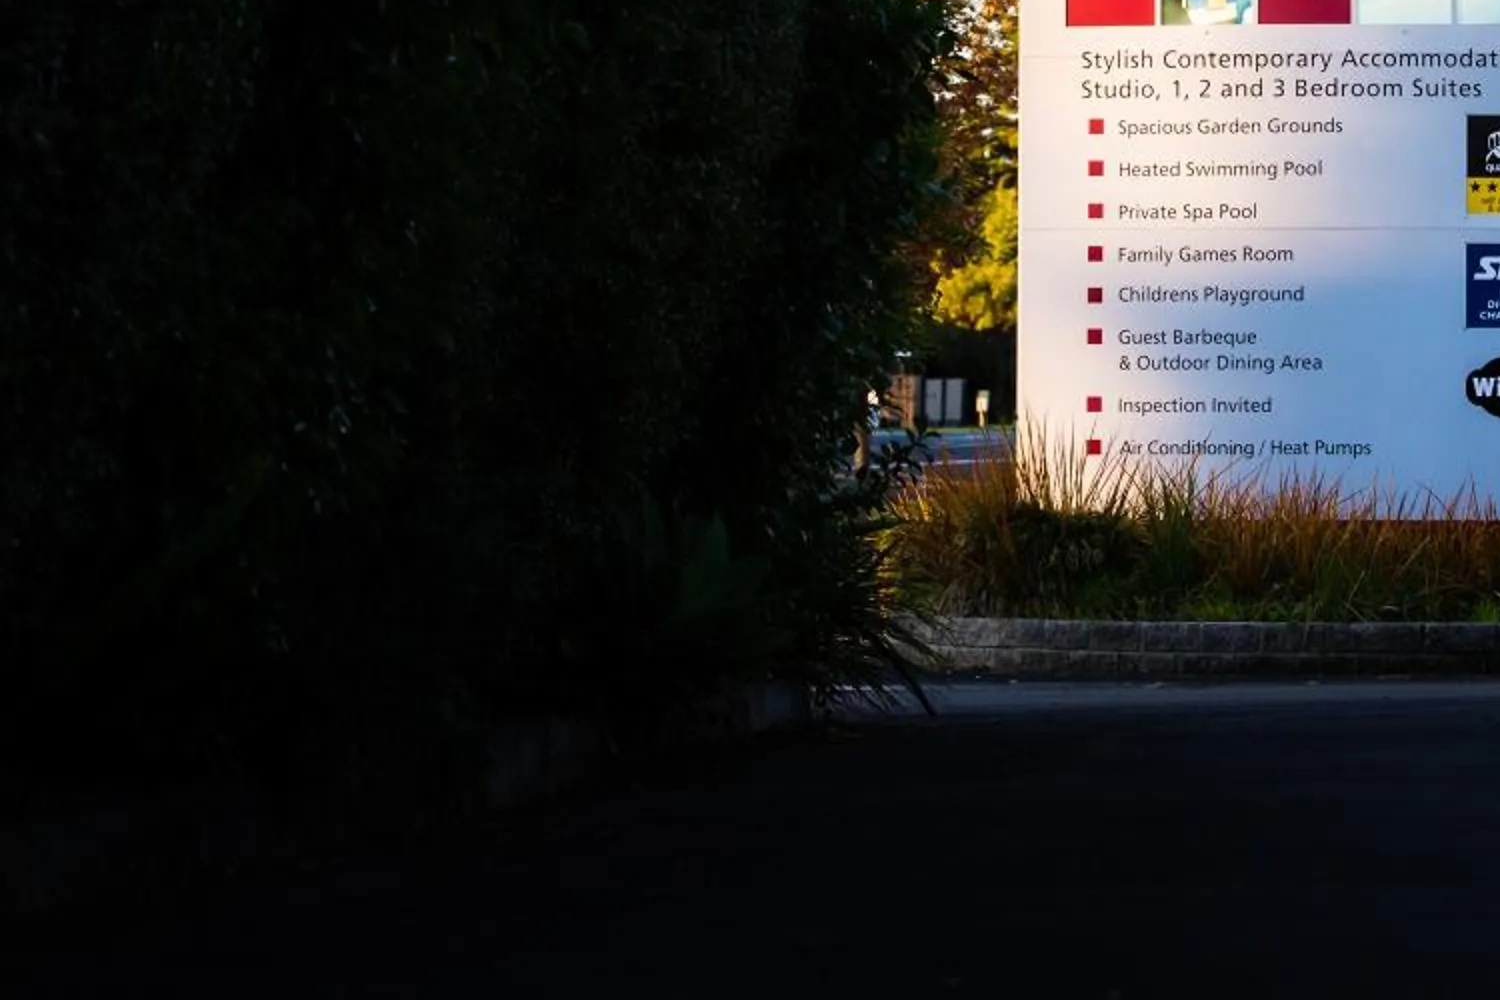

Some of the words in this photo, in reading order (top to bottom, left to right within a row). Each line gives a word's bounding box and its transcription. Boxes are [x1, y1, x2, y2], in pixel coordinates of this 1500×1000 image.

[1080, 49, 1154, 75] Stylish
[1163, 50, 1333, 74] Contemporary
[1080, 79, 1161, 101] Studio,
[1172, 80, 1190, 101] 1,
[1198, 80, 1212, 98] 2
[1220, 78, 1264, 99] and
[1273, 79, 1286, 98] 3
[1295, 78, 1404, 98] Bedroom
[1412, 77, 1483, 98] Suites
[1118, 119, 1192, 139] Spacious
[1197, 118, 1261, 135] Garden
[1267, 117, 1343, 134] Grounds
[1119, 161, 1181, 177] Heated
[1185, 160, 1278, 180] Swimming
[1284, 160, 1323, 176] Pool
[1119, 204, 1177, 220] Private
[1183, 203, 1213, 222] Spa
[1219, 202, 1257, 219] Pool
[1118, 245, 1173, 267] Family
[1178, 246, 1237, 263] Games
[1243, 245, 1294, 262] Room
[1118, 285, 1199, 303] Childrens
[1203, 285, 1304, 307] Playground
[1117, 329, 1167, 345] Guest
[1173, 328, 1257, 349] Barbeque
[1119, 355, 1131, 371] &
[1135, 354, 1211, 371] Outdoor
[1216, 354, 1275, 374] Dining
[1279, 354, 1323, 370] Area
[1118, 397, 1206, 417] Inspection
[1211, 397, 1272, 413] Invited
[1119, 440, 1143, 456] Air
[1147, 439, 1255, 460] Conditioning
[1270, 439, 1310, 456] Heat
[1315, 439, 1373, 459] Pumps
